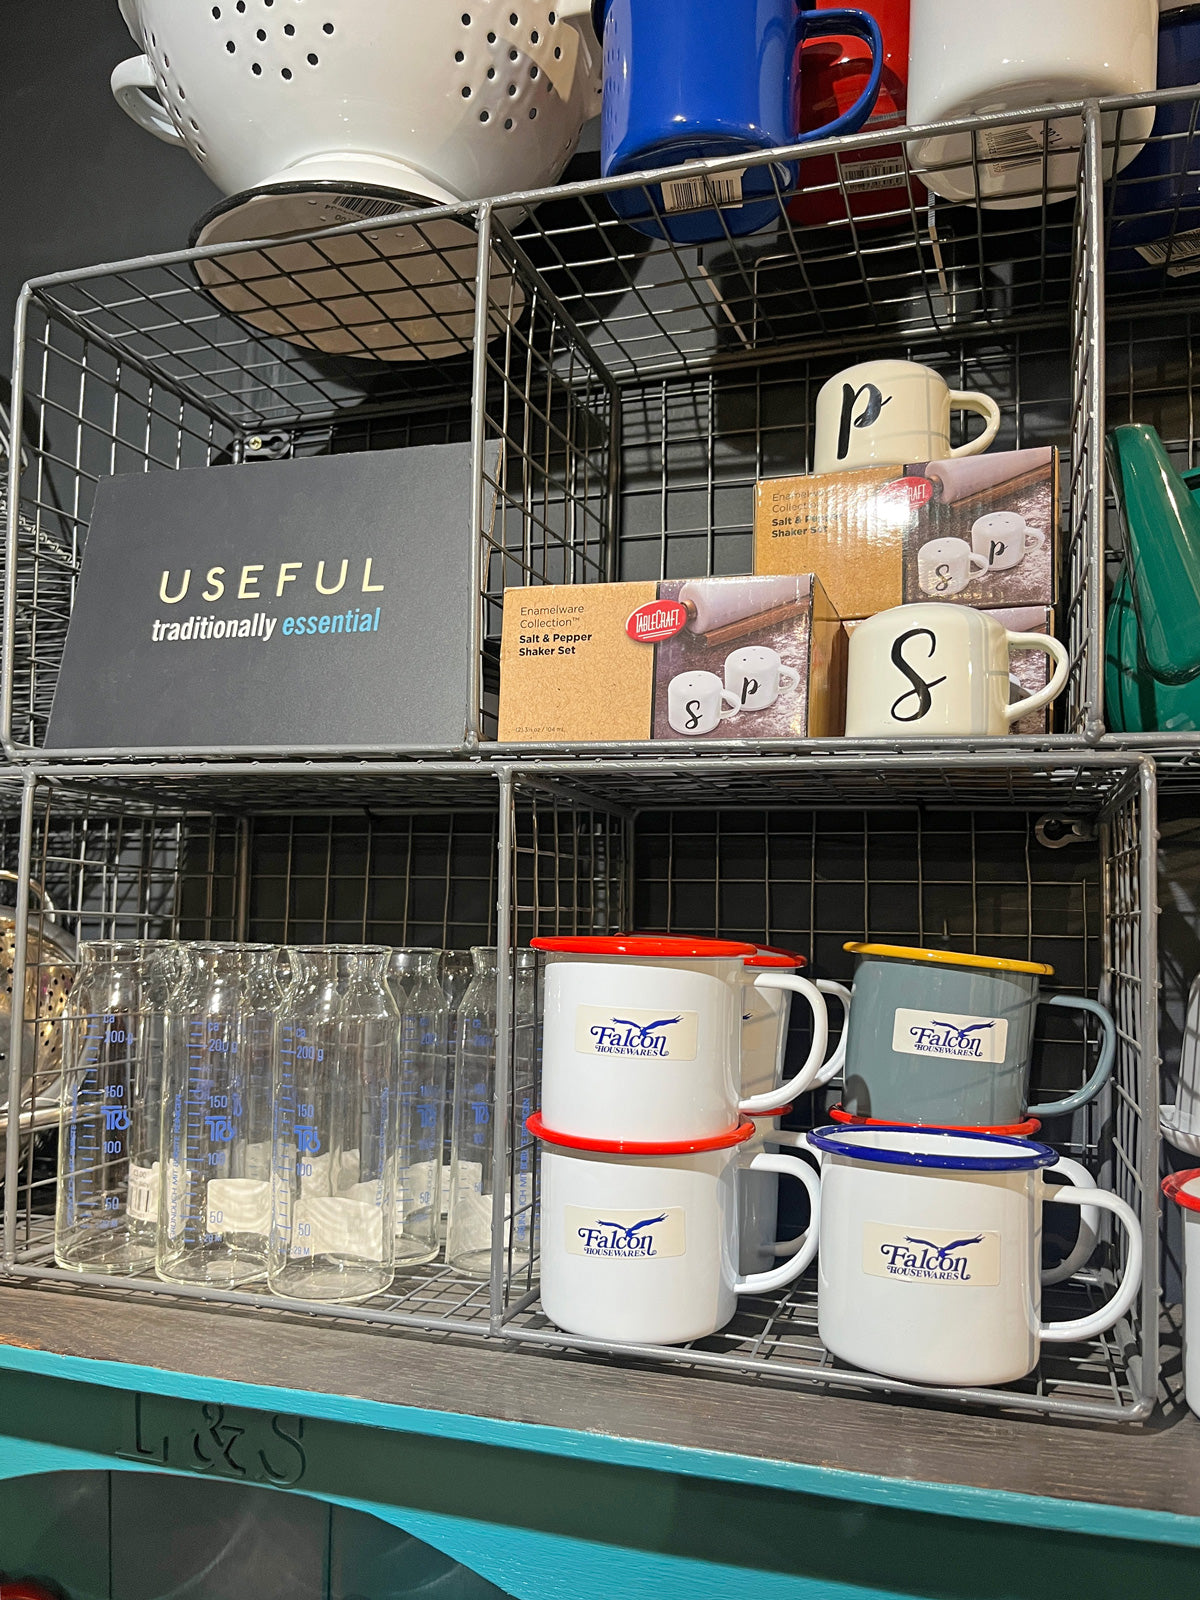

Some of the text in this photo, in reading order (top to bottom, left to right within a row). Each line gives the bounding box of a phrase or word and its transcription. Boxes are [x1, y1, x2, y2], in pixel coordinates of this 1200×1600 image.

[771, 517, 792, 526] Salt
[771, 528, 807, 538] Shaker
[159, 557, 385, 604] USEFUL
[520, 605, 585, 616] Enamelware
[151, 607, 381, 642] traditionally essential
[519, 633, 593, 644] Salt & Pepper
[519, 645, 576, 657] Shaker Set
[208, 1039, 229, 1053] 200
[590, 1025, 669, 1057] Falcon
[910, 1026, 983, 1057] Falcon
[297, 1045, 324, 1062] 200 g
[595, 1044, 658, 1057] HOUSEWARES
[914, 1043, 974, 1057] HOUSEWARES
[210, 1095, 228, 1109] 150
[297, 1104, 315, 1118] 150
[103, 1140, 121, 1154] 100
[296, 1163, 313, 1177] 100
[209, 1210, 224, 1224] 50
[298, 1223, 311, 1237] 50
[577, 1227, 656, 1256] Falcon
[583, 1247, 646, 1257] HOUSEWARES
[880, 1243, 970, 1281] Falcon
[886, 1265, 959, 1281] HOUSEWARES
[115, 1393, 306, 1490] L & S
